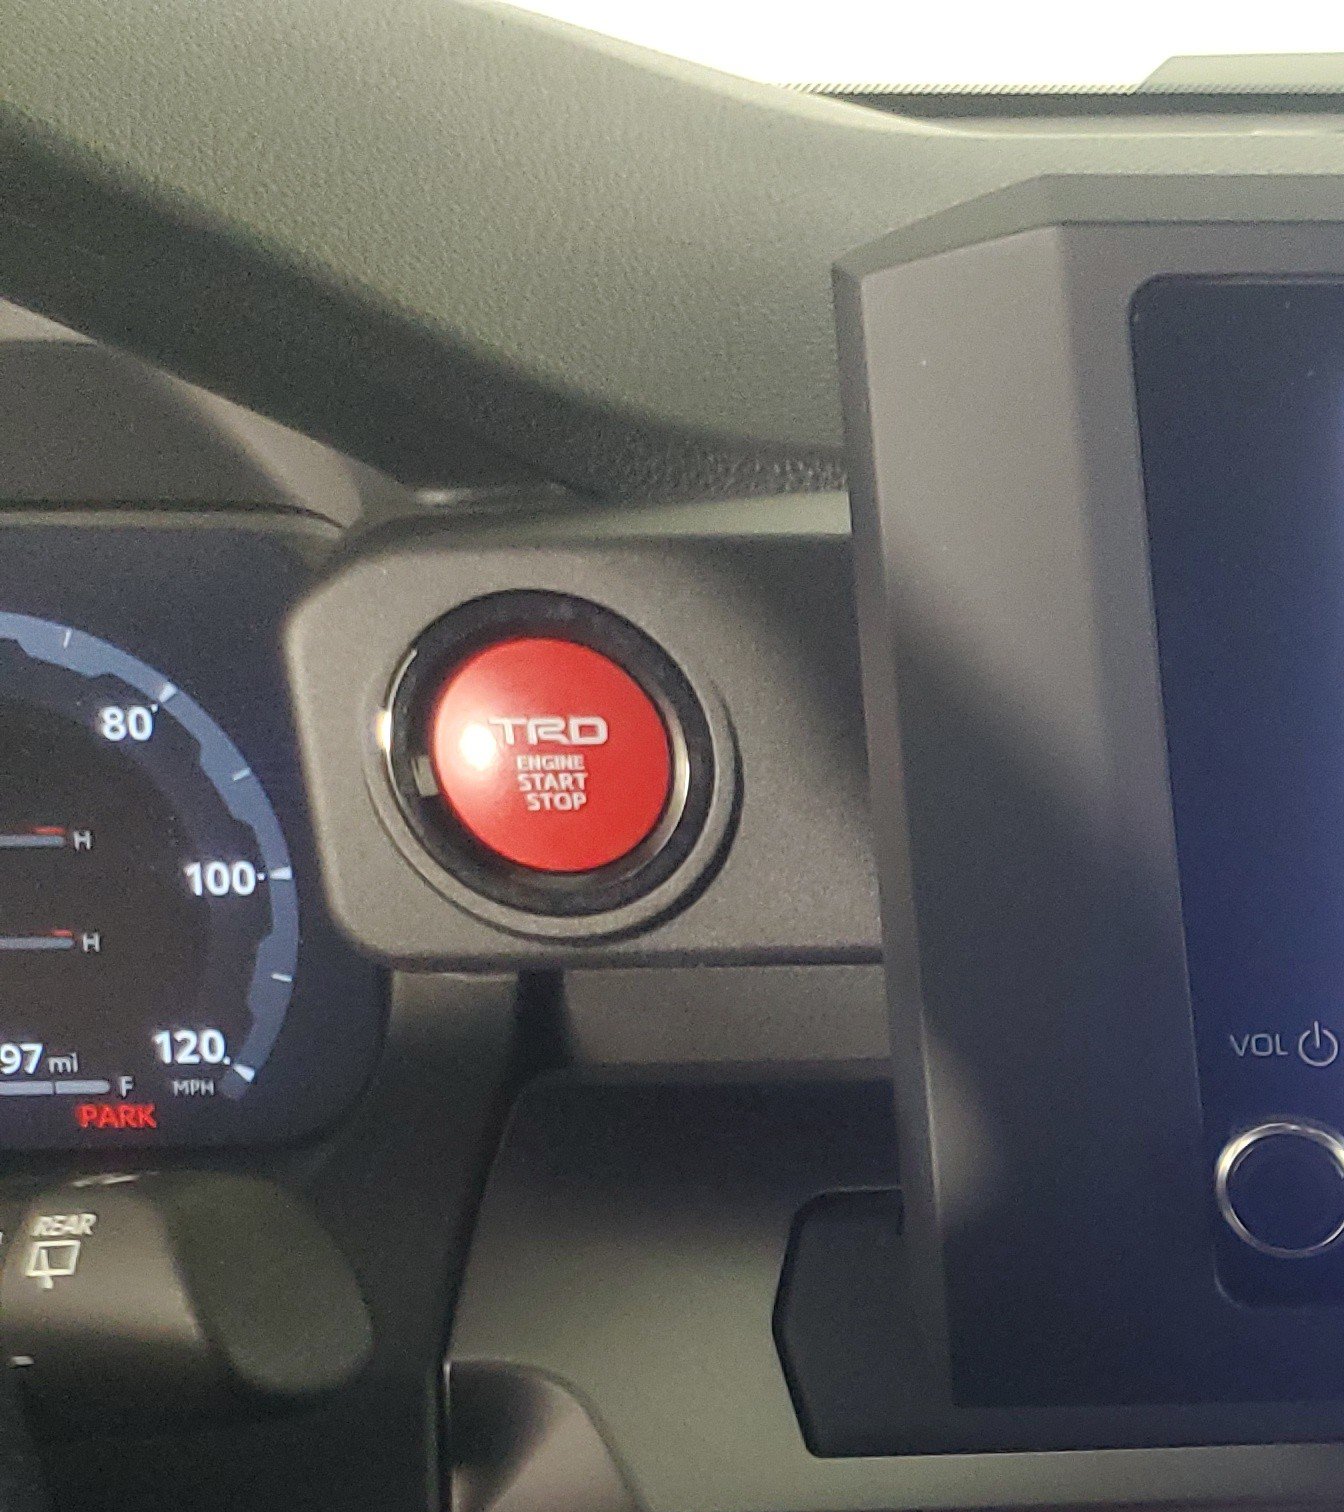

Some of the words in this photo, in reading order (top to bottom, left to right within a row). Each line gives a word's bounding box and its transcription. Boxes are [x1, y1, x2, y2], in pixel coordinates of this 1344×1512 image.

[101, 705, 153, 742] 80
[488, 715, 609, 746] TRD
[516, 753, 585, 771] ENGINE
[517, 772, 588, 791] START
[526, 791, 587, 811] STOP
[73, 830, 92, 851] H
[183, 860, 256, 897] 100
[82, 931, 100, 952] H
[153, 1028, 227, 1066] 120
[1230, 1031, 1289, 1058] VOL
[48, 1051, 79, 1074] mi
[118, 1075, 135, 1098] F
[172, 1078, 215, 1097] MPH
[76, 1103, 157, 1129] PARK
[32, 1212, 98, 1237] REAR
